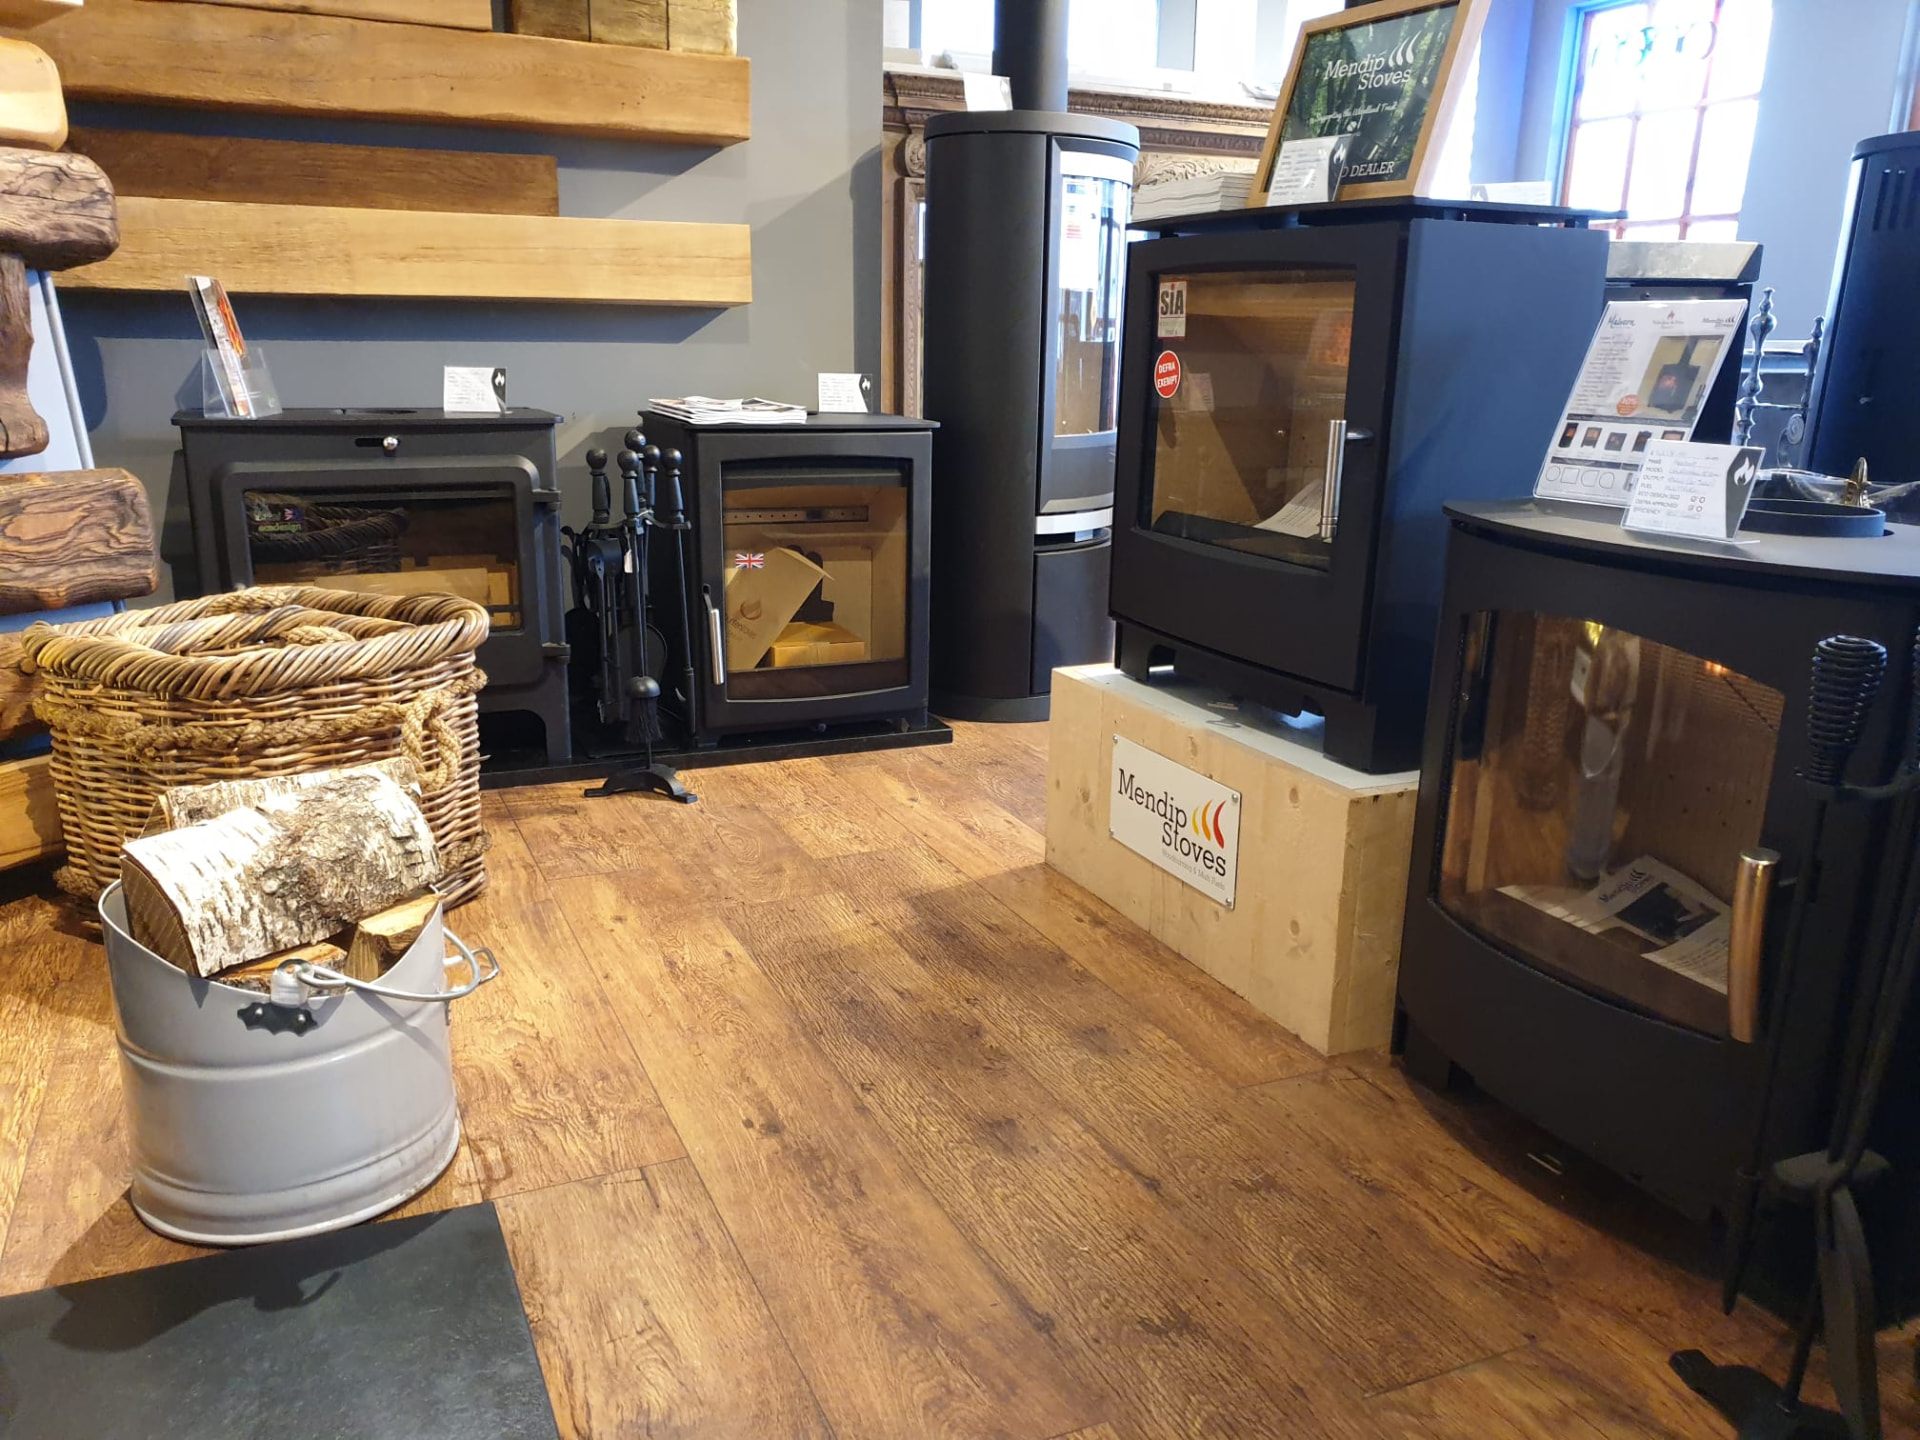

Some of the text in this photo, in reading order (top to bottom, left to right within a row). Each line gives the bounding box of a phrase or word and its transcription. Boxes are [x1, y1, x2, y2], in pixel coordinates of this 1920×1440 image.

[1324, 53, 1385, 80] Mendip
[1358, 69, 1412, 90] Stoves
[1350, 161, 1395, 177] DEALER
[1118, 768, 1187, 829] Mendip
[1162, 822, 1227, 877] Stoves
